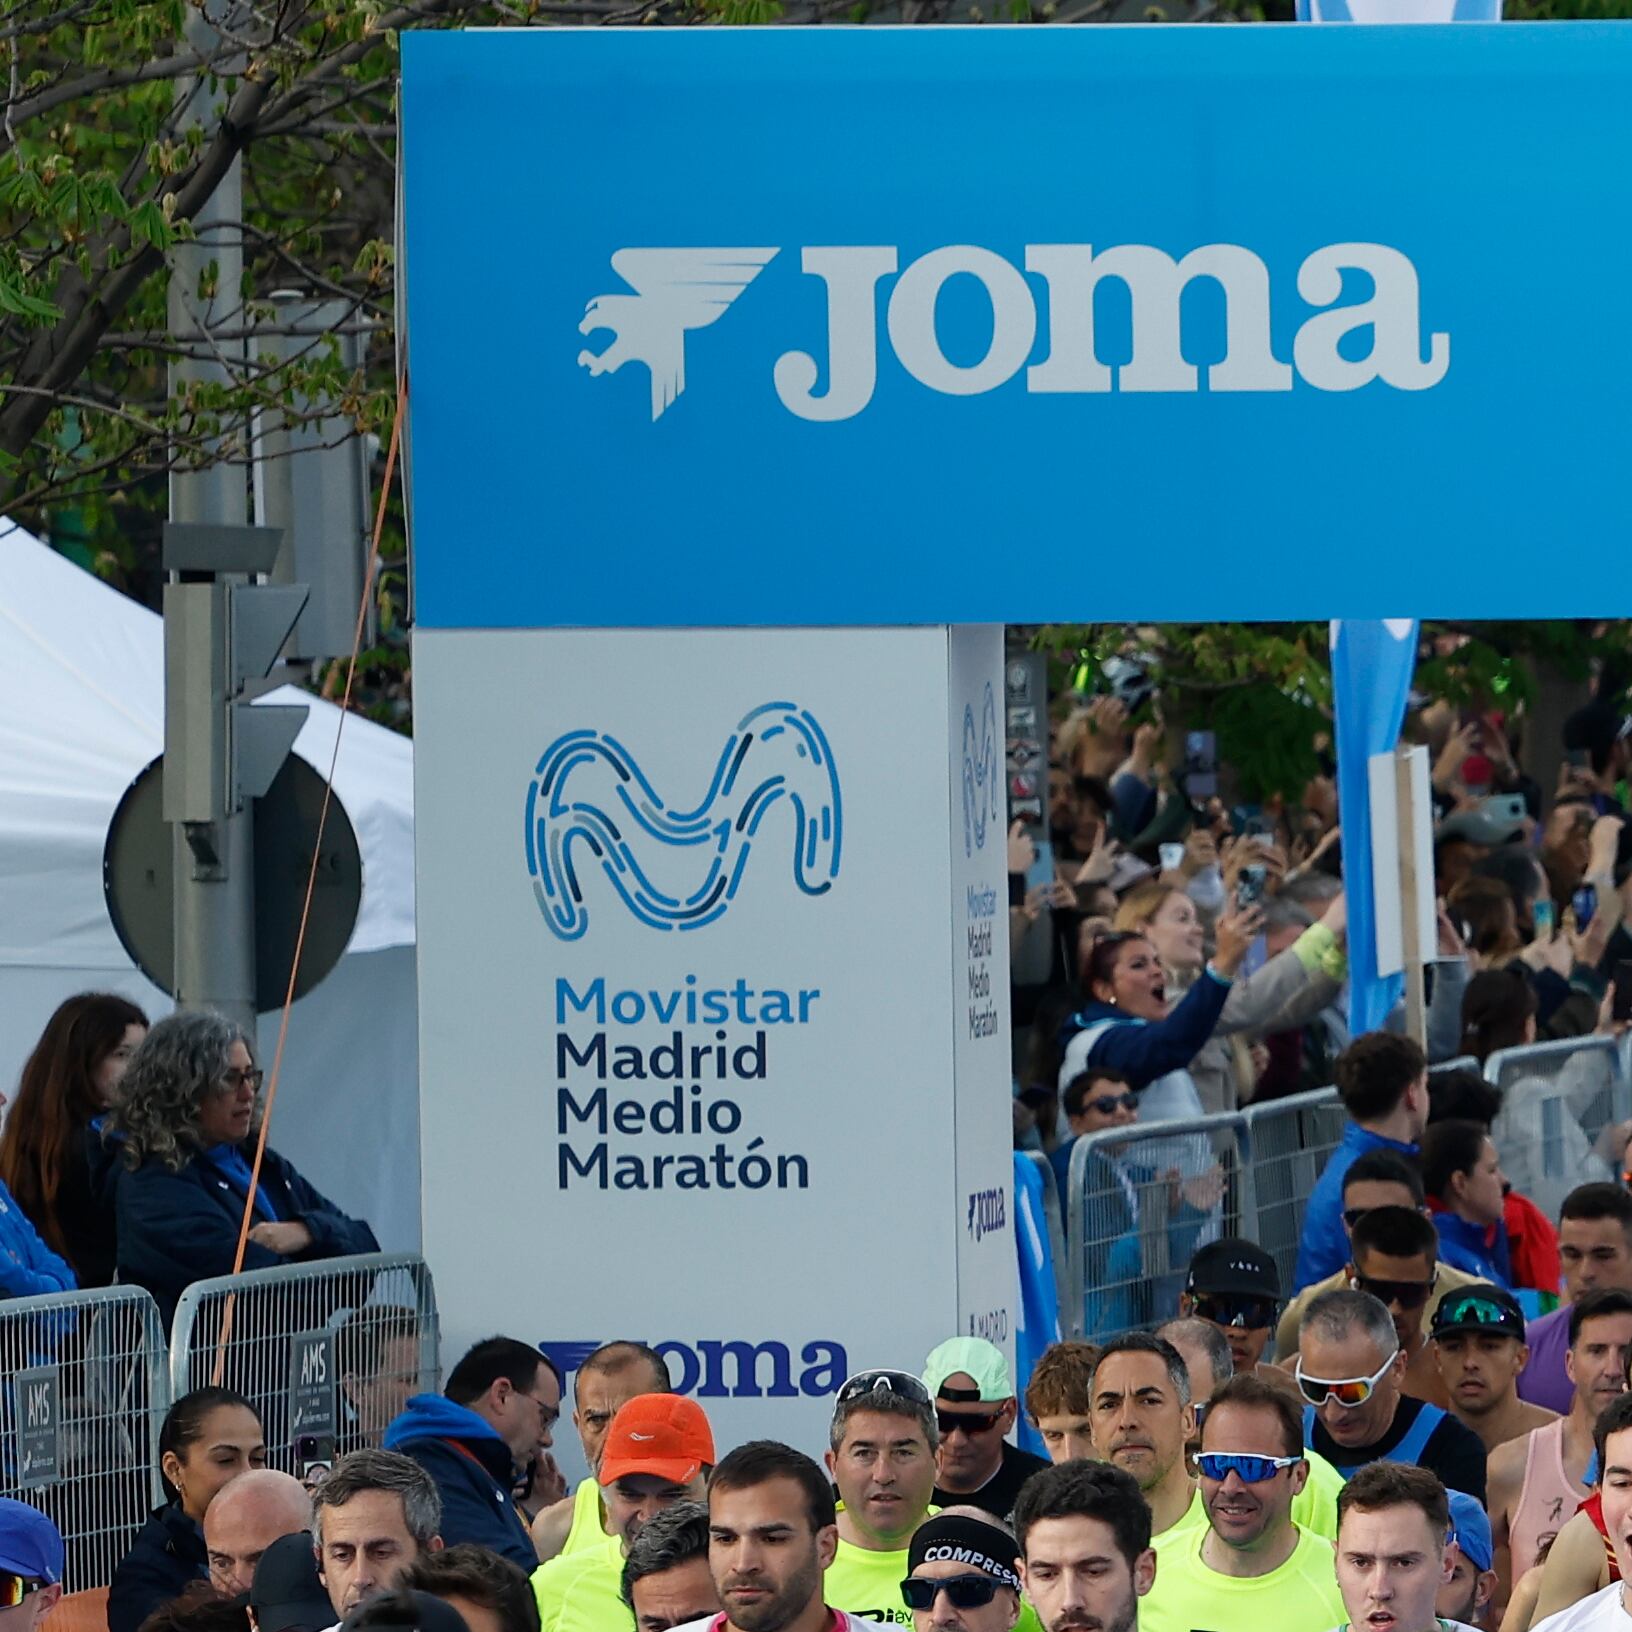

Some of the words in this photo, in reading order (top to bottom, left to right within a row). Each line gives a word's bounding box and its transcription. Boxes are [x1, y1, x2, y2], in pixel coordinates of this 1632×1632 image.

[774, 242, 1450, 422] Joma
[967, 884, 997, 918] Movistar
[968, 920, 993, 961] Madrid
[556, 973, 821, 1026] Movistar
[968, 963, 991, 1000] Medio
[969, 998, 998, 1040] Maratón
[556, 1031, 767, 1080] Madrid
[557, 1085, 743, 1136] Medio
[558, 1137, 809, 1191] Maratón
[978, 1308, 1007, 1344] MADRID
[301, 1342, 326, 1386] AMS
[640, 1340, 849, 1398] oma
[29, 1382, 51, 1428] AMS
